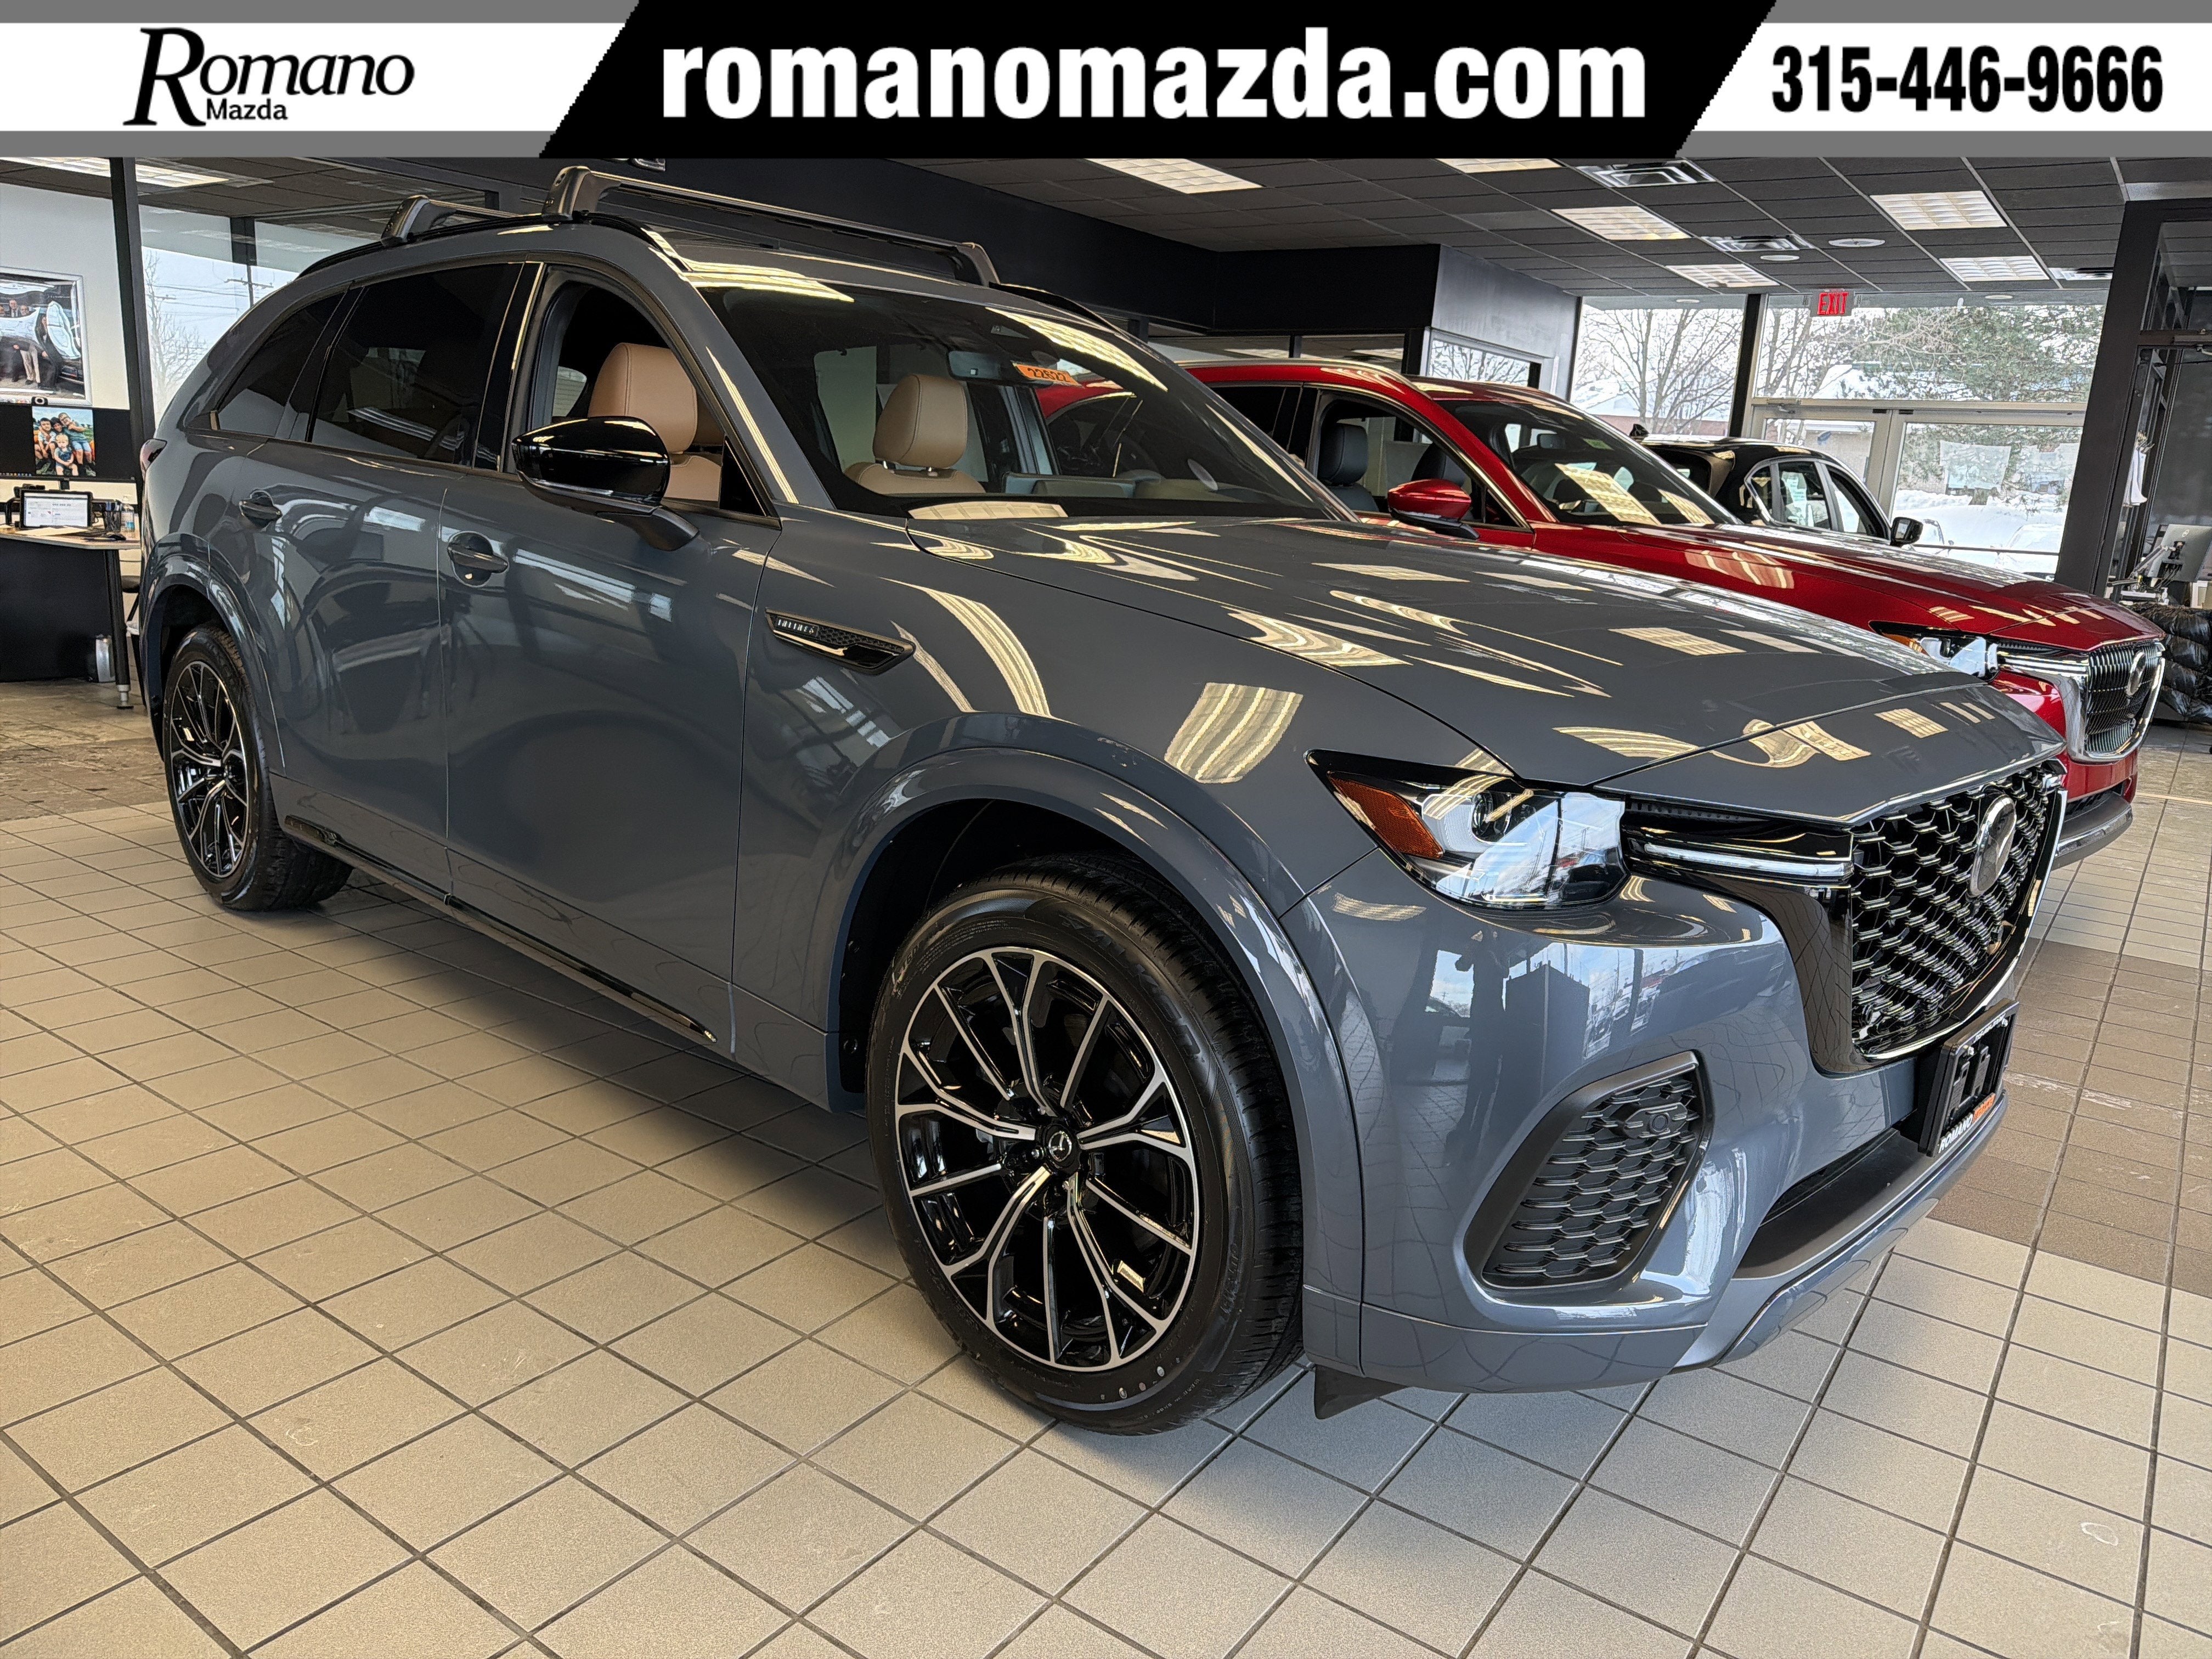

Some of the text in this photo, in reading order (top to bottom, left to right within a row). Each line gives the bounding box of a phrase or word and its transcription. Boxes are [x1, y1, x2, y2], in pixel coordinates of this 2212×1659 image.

[1818, 292, 1849, 315] EXIT
[1028, 367, 1071, 383] 22622
[1938, 1113, 1974, 1154] ROMANO
